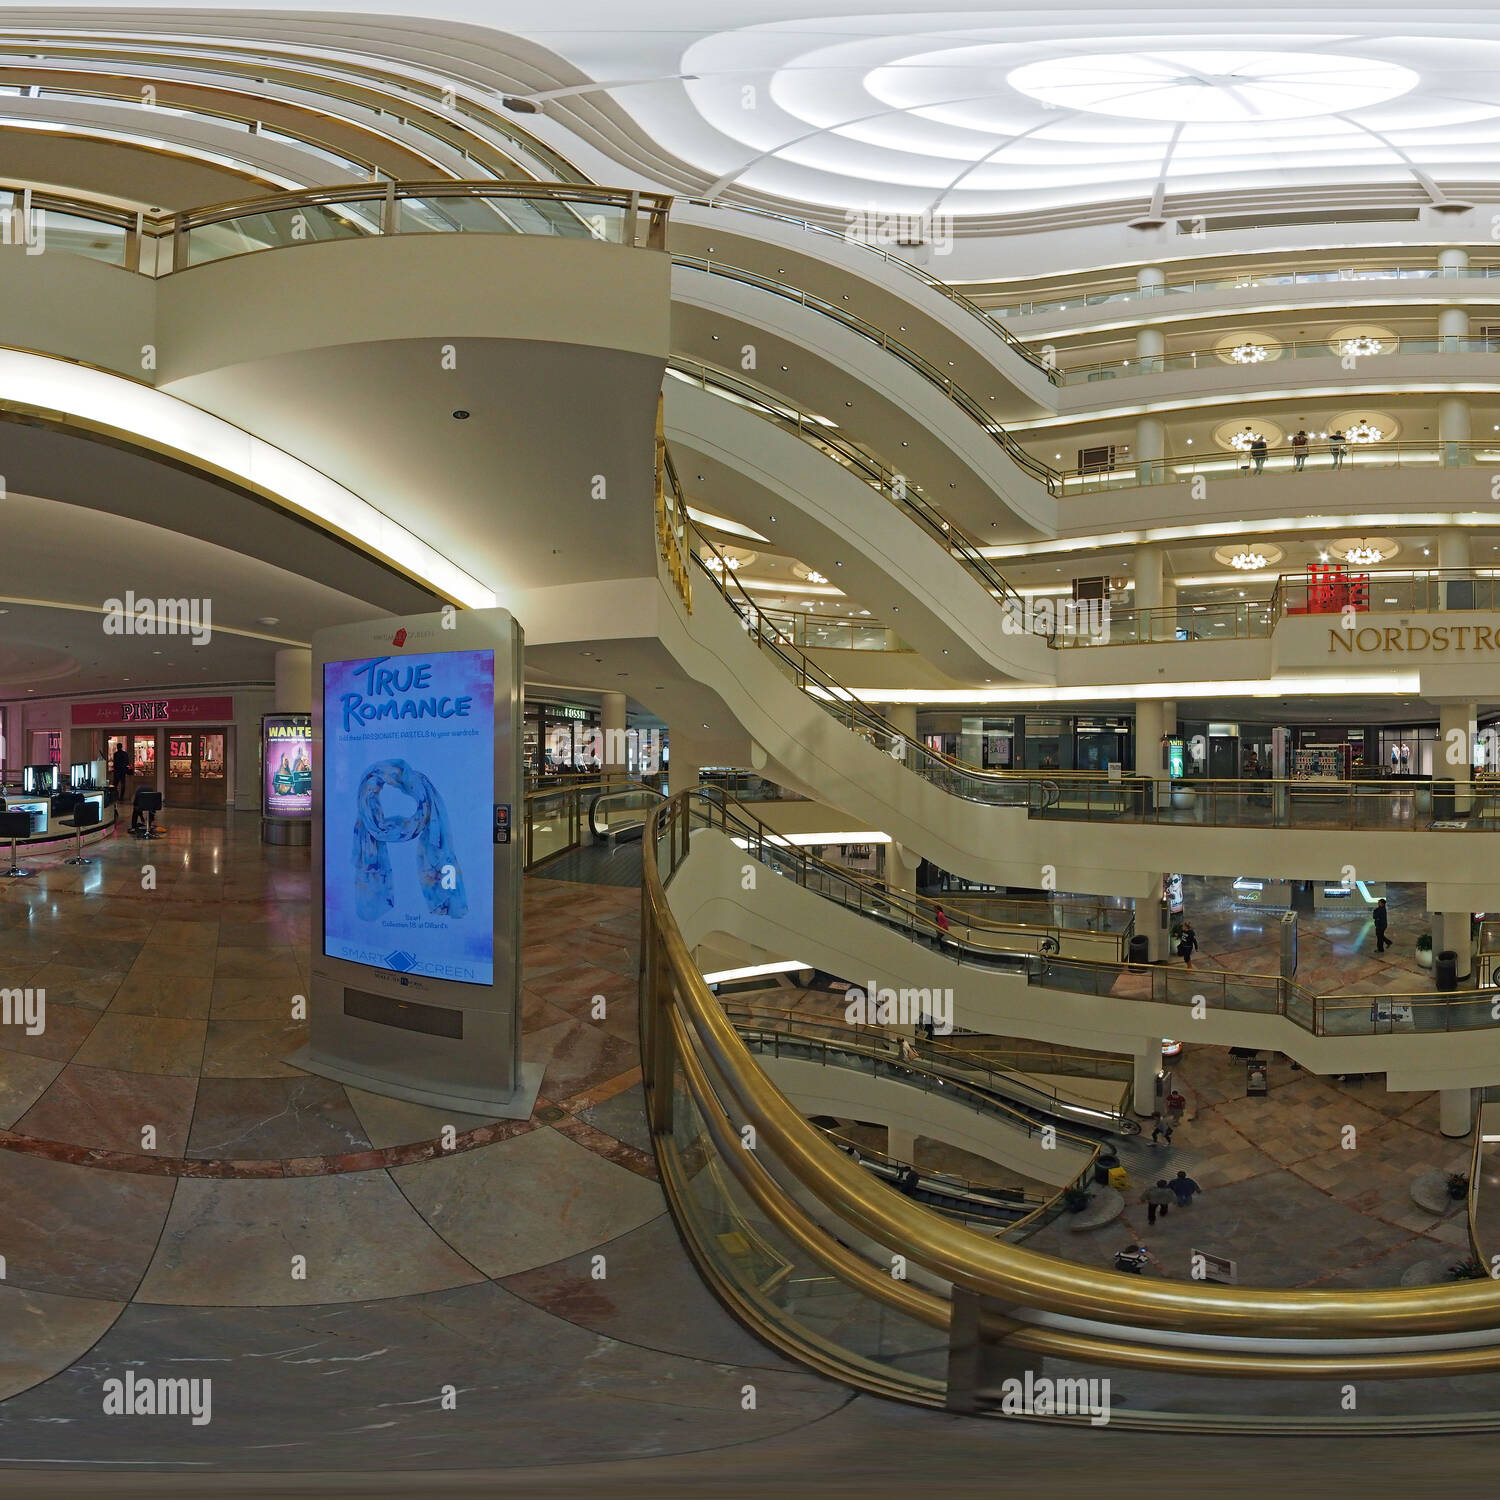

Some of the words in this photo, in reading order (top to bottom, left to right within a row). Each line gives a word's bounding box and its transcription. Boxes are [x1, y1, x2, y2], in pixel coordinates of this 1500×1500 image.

[352, 656, 433, 697] TRUE
[120, 701, 169, 721] PINK
[339, 692, 473, 733] ROMANCE
[341, 947, 385, 962] SMART
[417, 961, 475, 979] SCREEN
